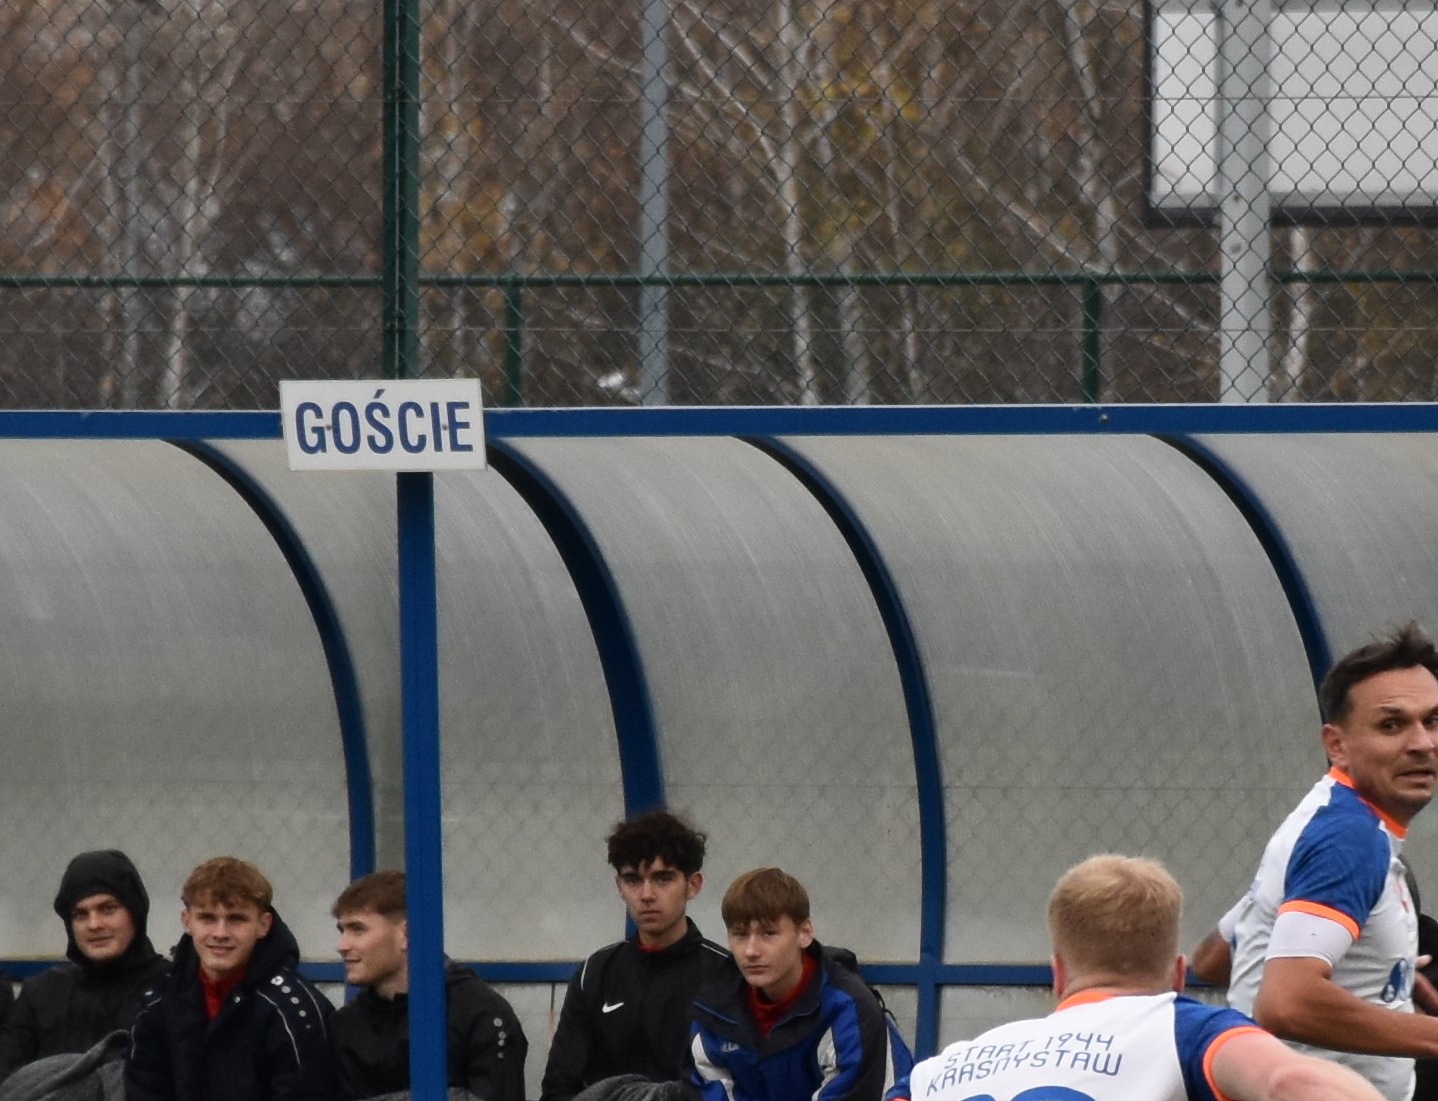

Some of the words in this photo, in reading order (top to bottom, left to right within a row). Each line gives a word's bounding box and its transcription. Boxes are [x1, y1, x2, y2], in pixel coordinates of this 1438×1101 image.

[295, 389, 473, 454] GOŚCIE
[926, 1049, 1123, 1097] KRASNYSTAW
[944, 1039, 1035, 1069] START
[1045, 1032, 1114, 1051] 1944
